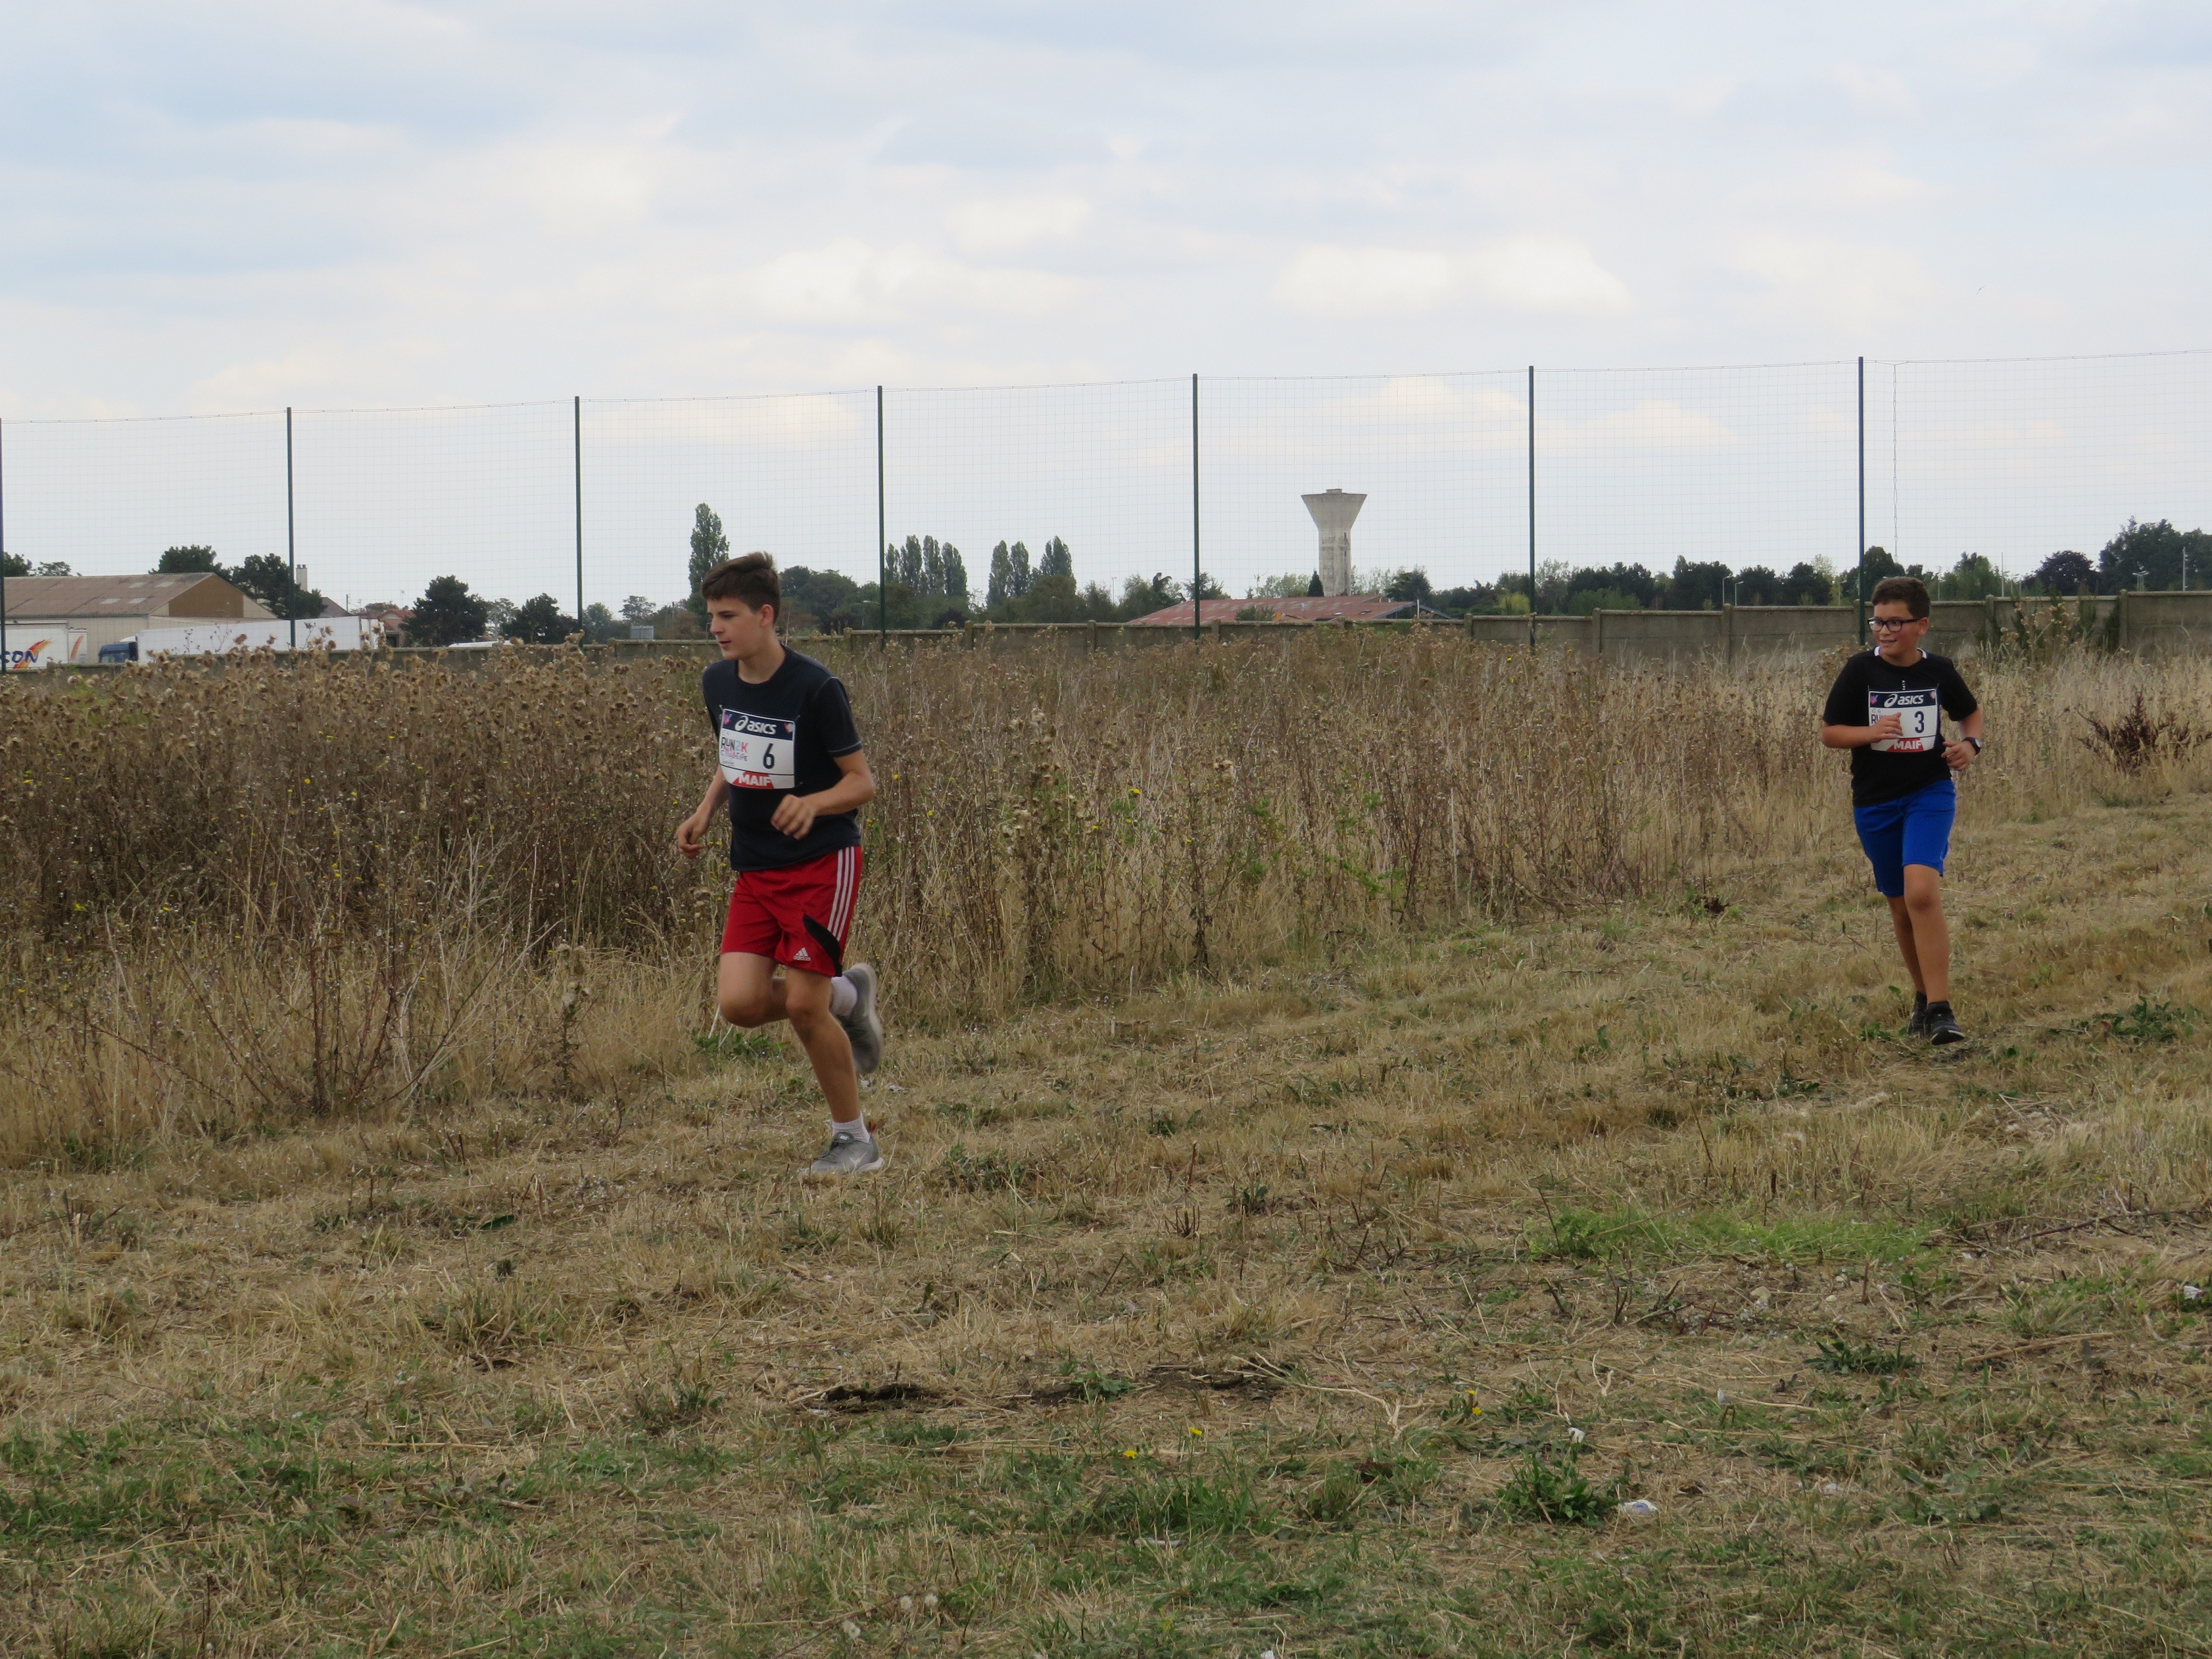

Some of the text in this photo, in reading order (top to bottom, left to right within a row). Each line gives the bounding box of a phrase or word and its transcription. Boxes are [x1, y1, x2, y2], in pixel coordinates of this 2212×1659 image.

[1898, 695, 1924, 706] asics
[747, 721, 777, 735] asics
[1914, 711, 1925, 733] 3
[1893, 741, 1922, 750] MAIF
[763, 743, 775, 769] 6
[738, 774, 772, 786] MAIF
